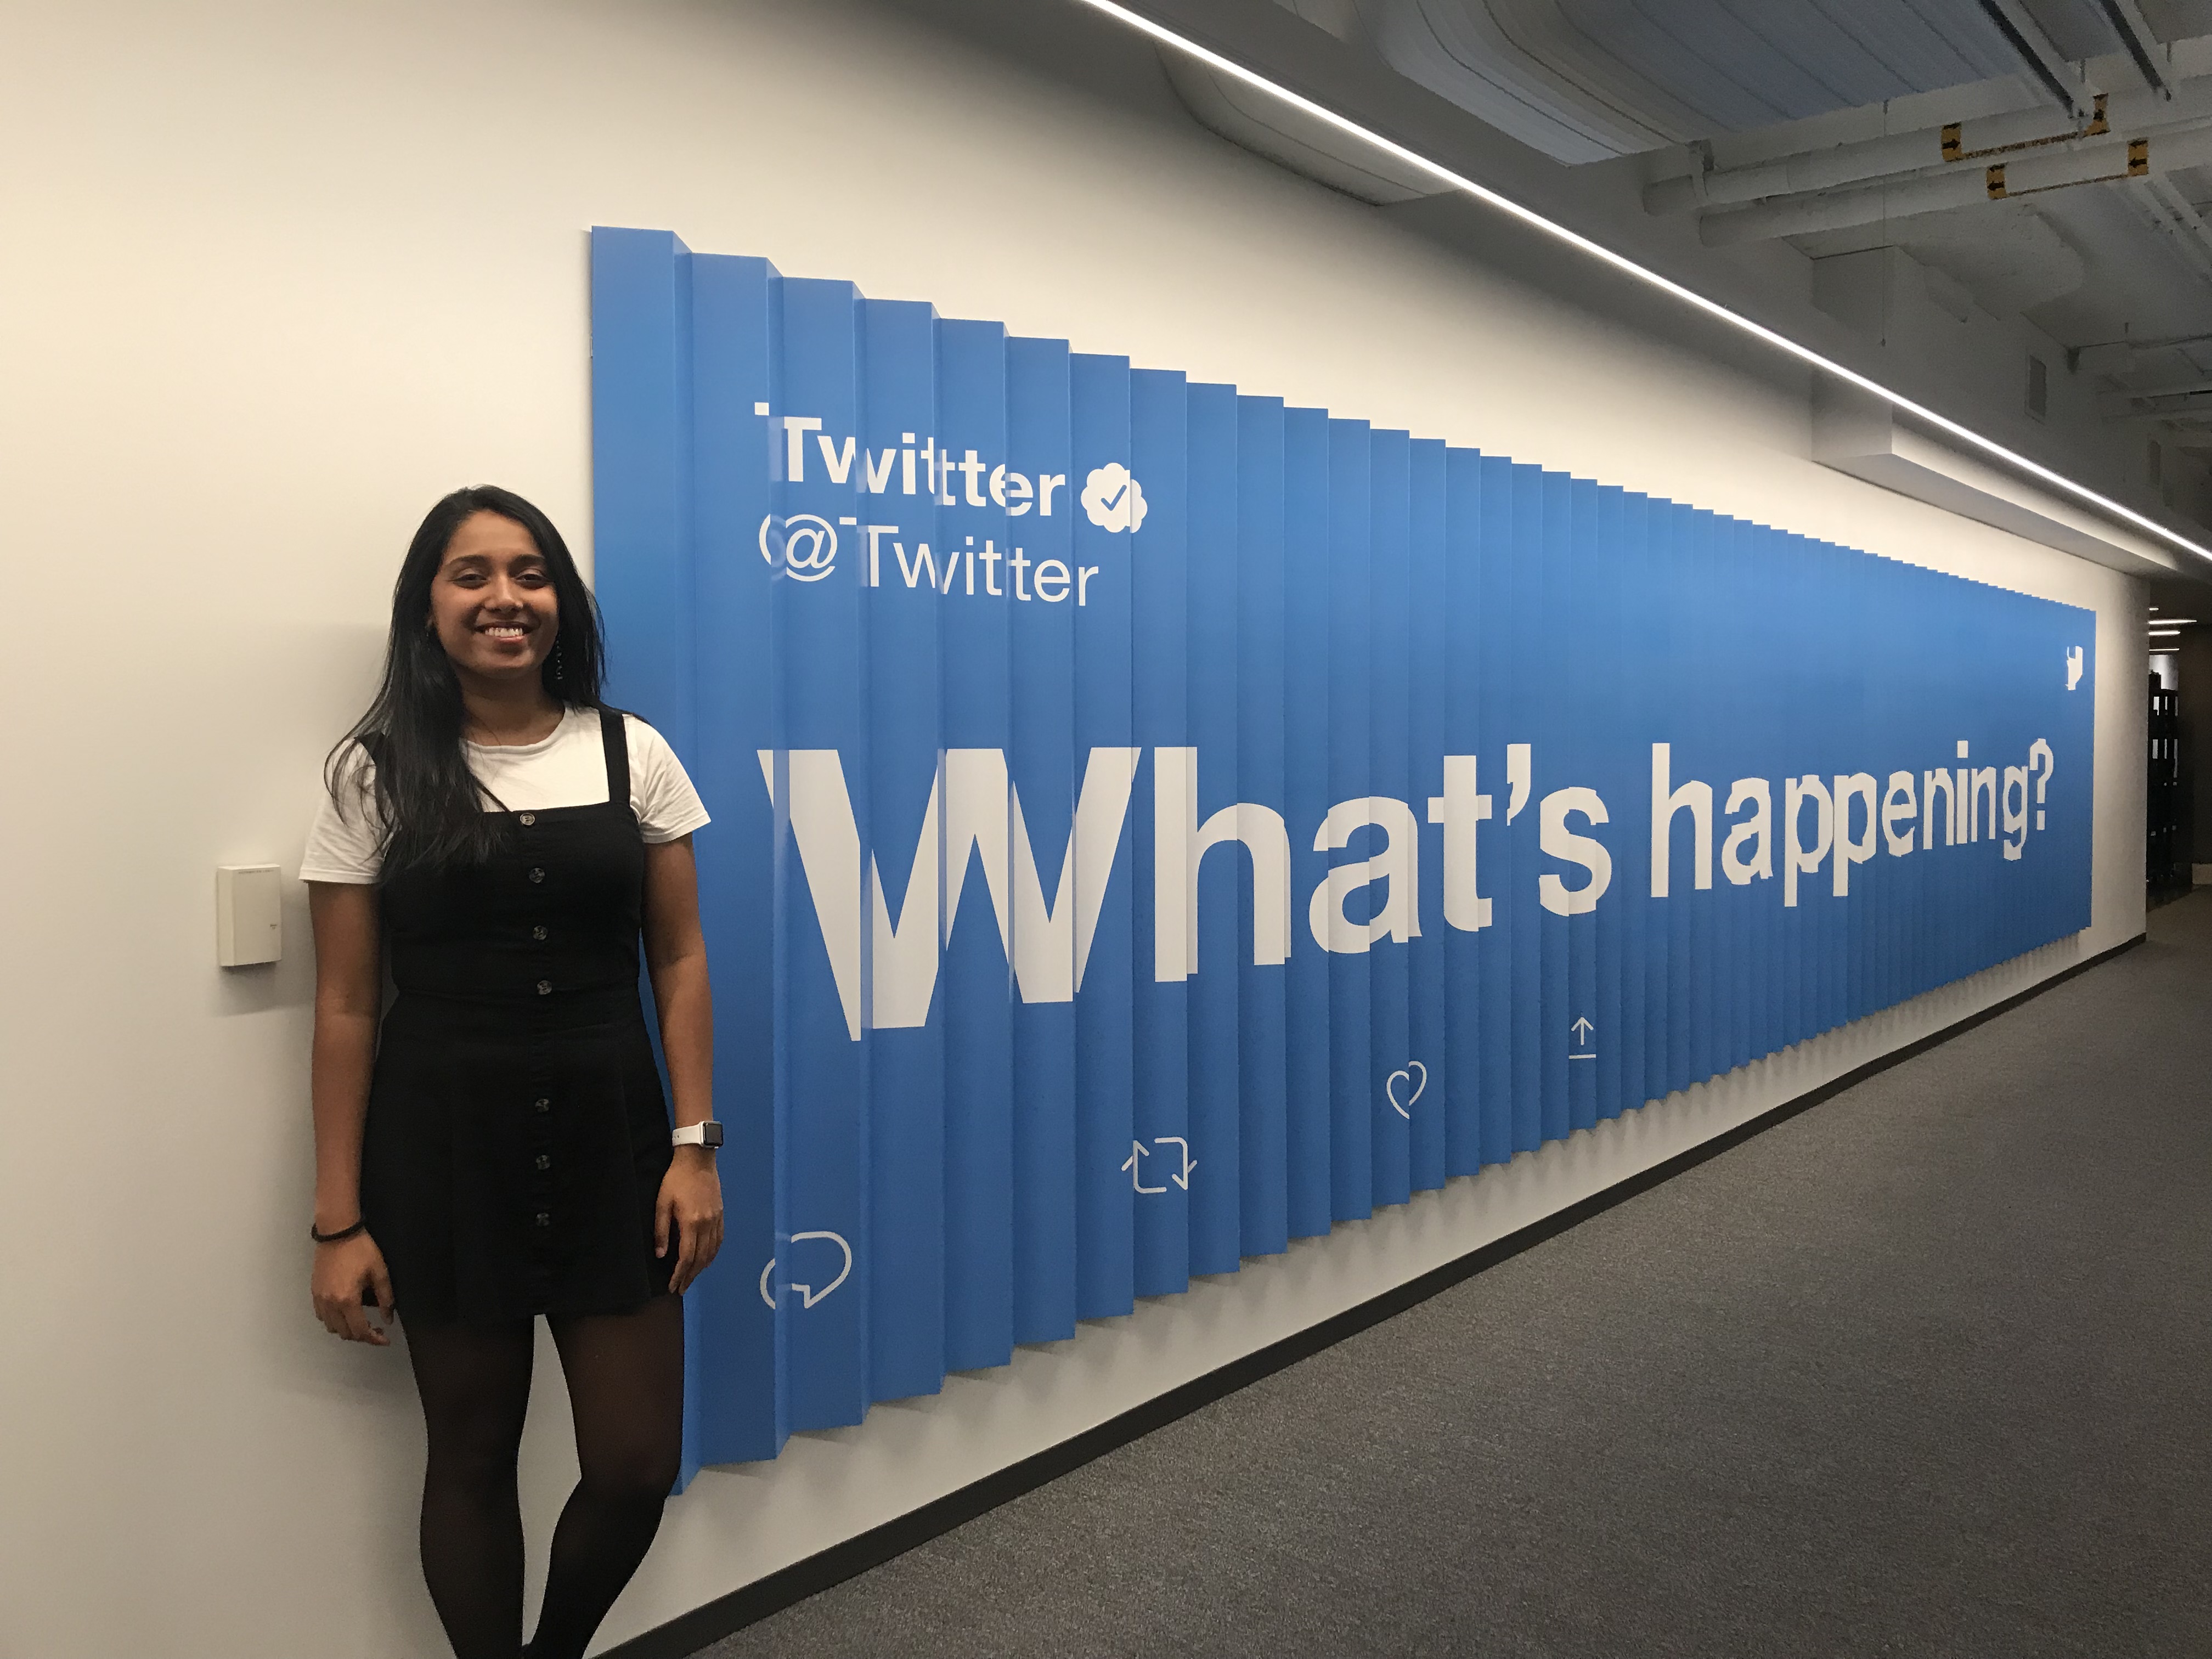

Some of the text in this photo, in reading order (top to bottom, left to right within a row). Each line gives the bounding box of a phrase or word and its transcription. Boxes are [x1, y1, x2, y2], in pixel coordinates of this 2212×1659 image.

[755, 402, 1065, 516] Twitter
[759, 514, 1099, 606] @Twitter
[757, 738, 2054, 1041] What's happening?
